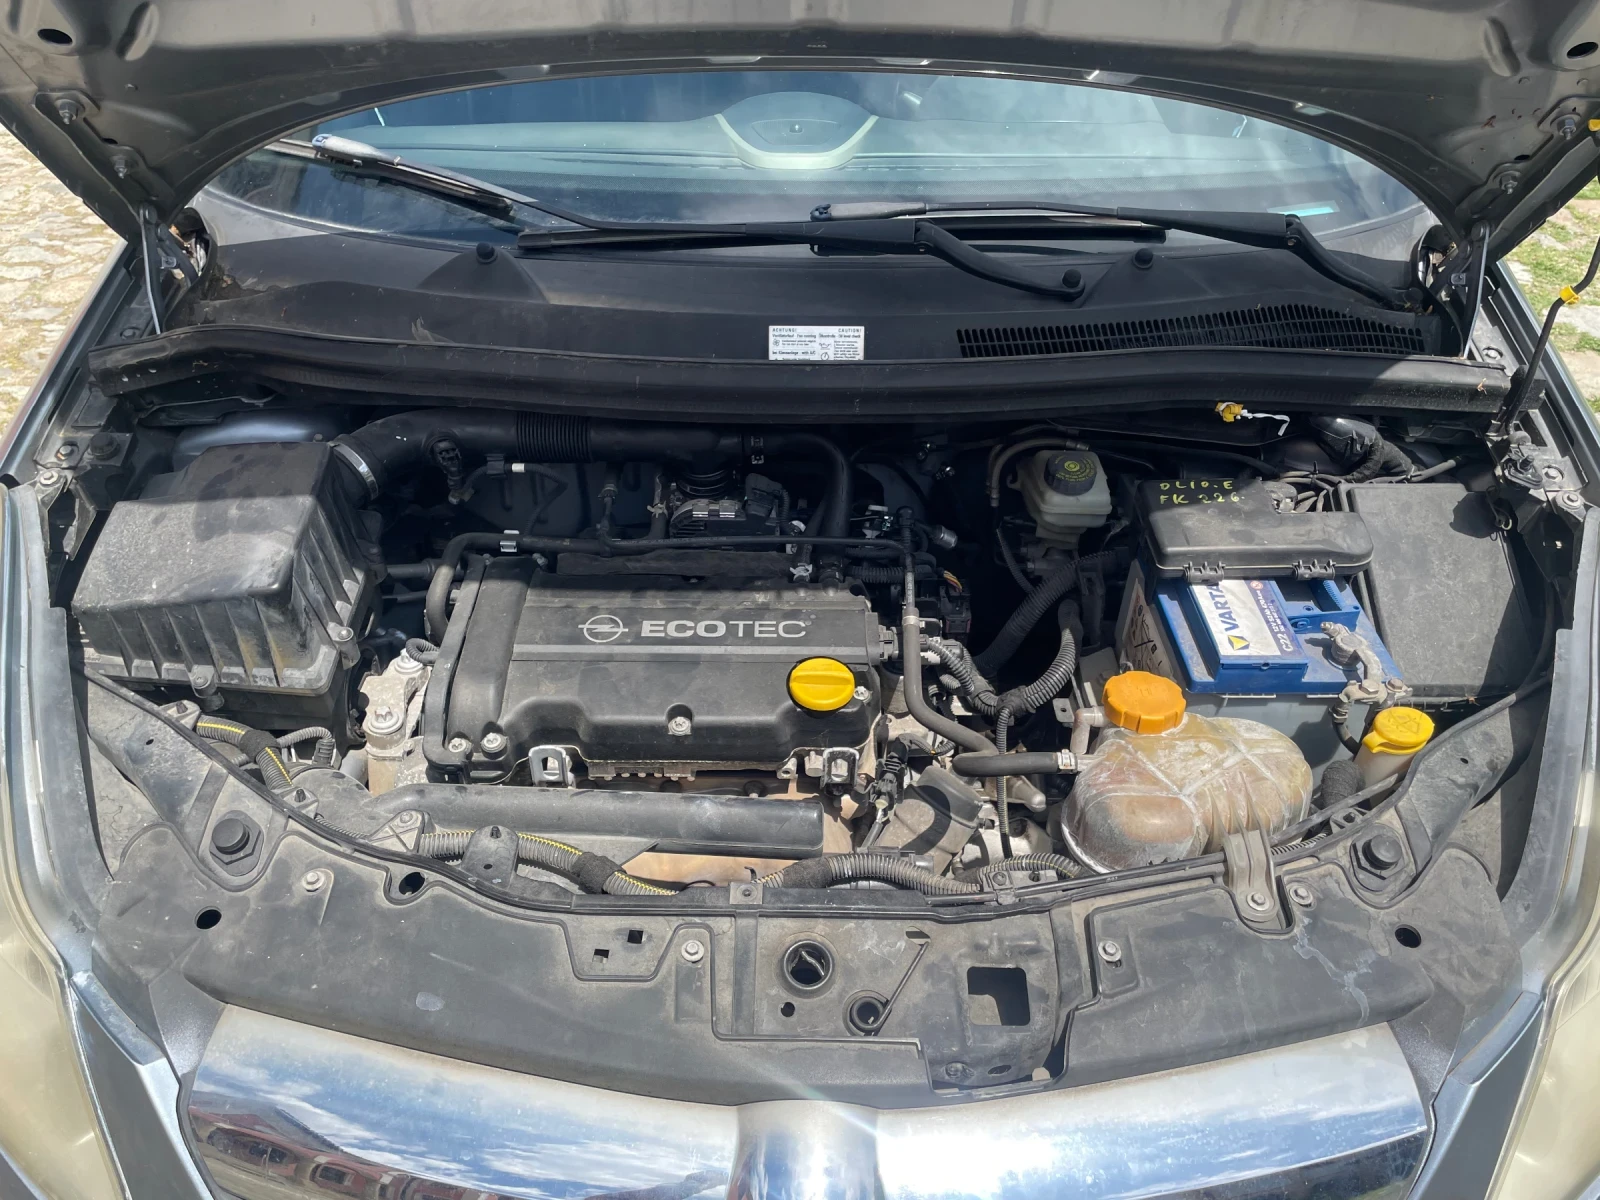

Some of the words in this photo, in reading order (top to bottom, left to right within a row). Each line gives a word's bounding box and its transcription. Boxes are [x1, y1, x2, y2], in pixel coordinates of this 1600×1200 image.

[1206, 582, 1239, 632] VARTA
[640, 620, 807, 638] ECOTEC
[1275, 633, 1294, 651] C22
